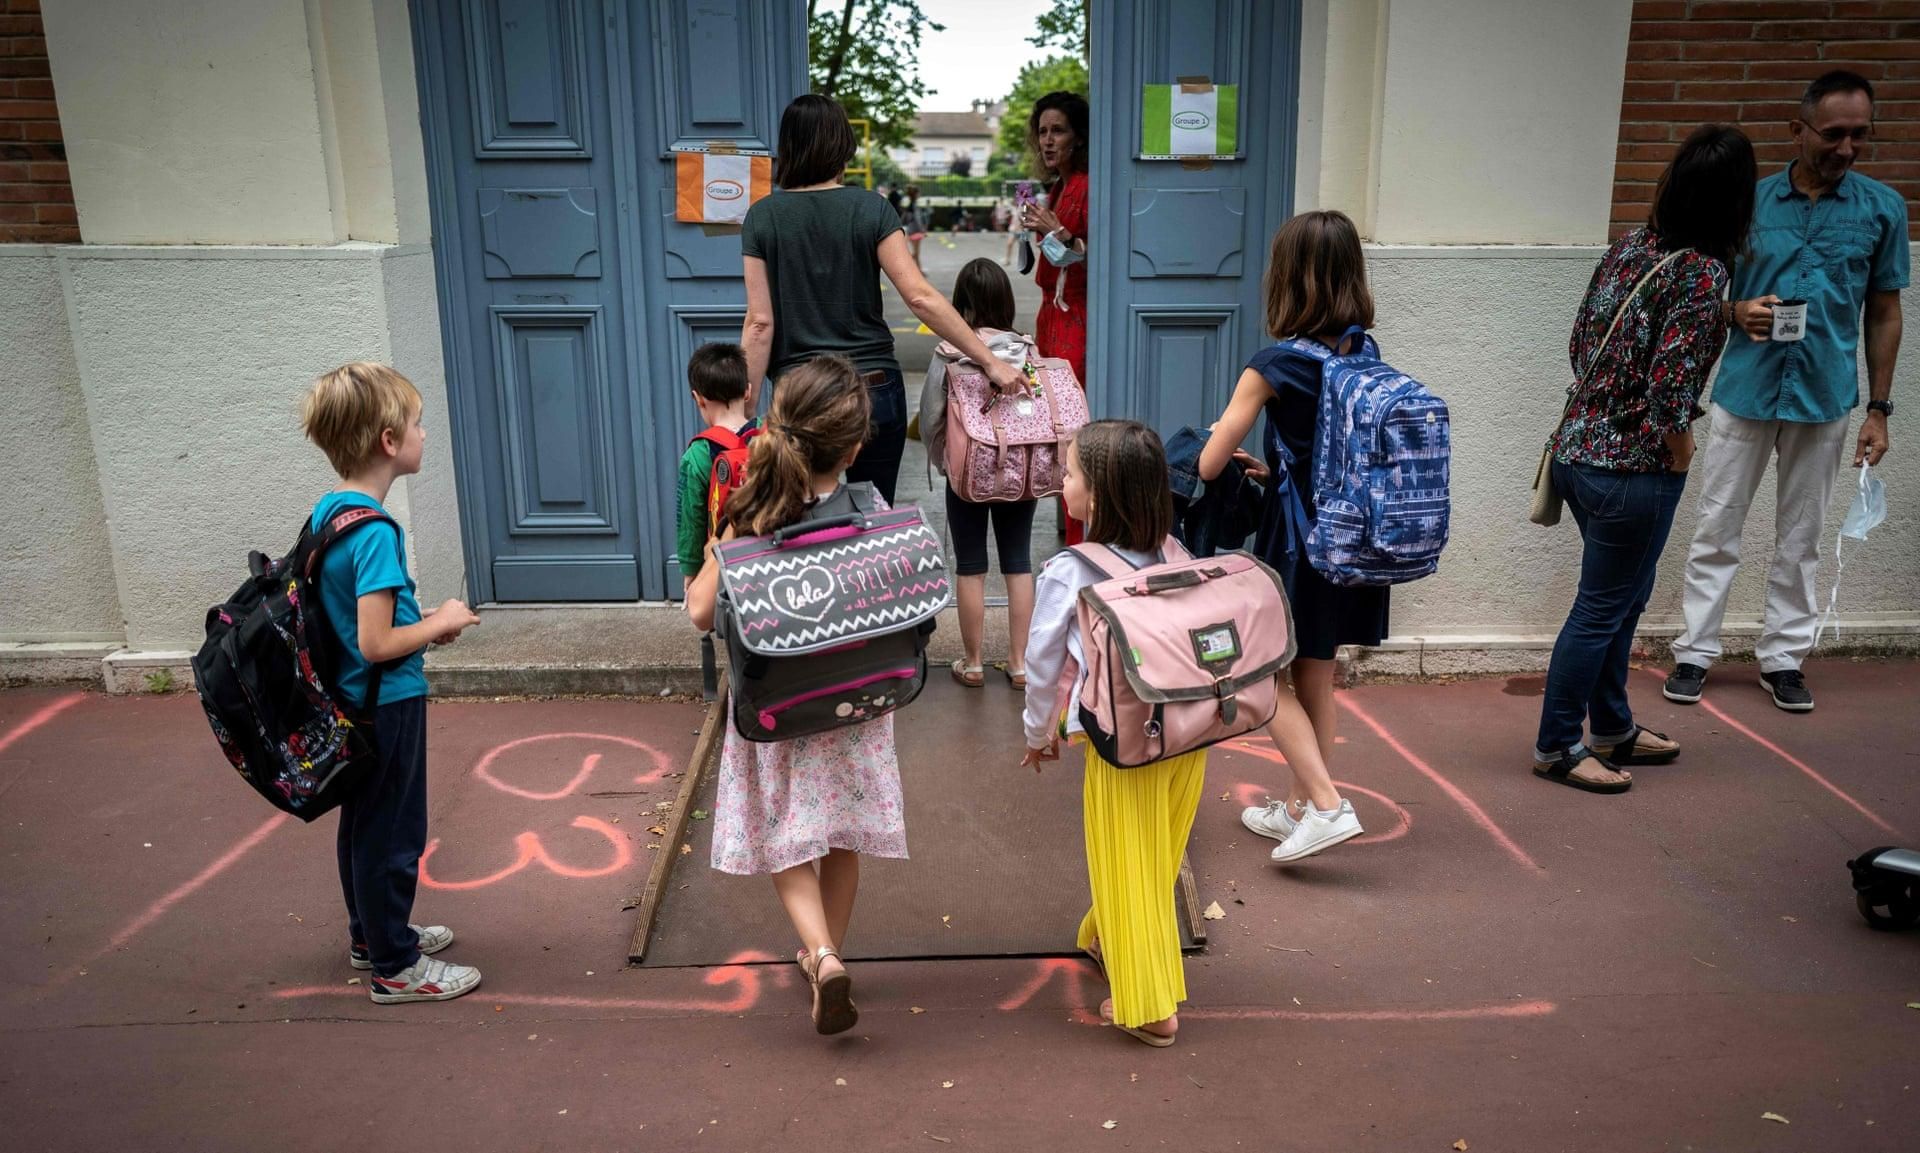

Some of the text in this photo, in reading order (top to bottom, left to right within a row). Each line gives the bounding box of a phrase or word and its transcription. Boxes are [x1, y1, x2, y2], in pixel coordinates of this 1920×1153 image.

[1175, 117, 1200, 126] Groupe
[708, 187, 733, 195] Groupe
[837, 555, 915, 595] ESPELETA
[786, 580, 824, 609] lola
[854, 597, 870, 609] all
